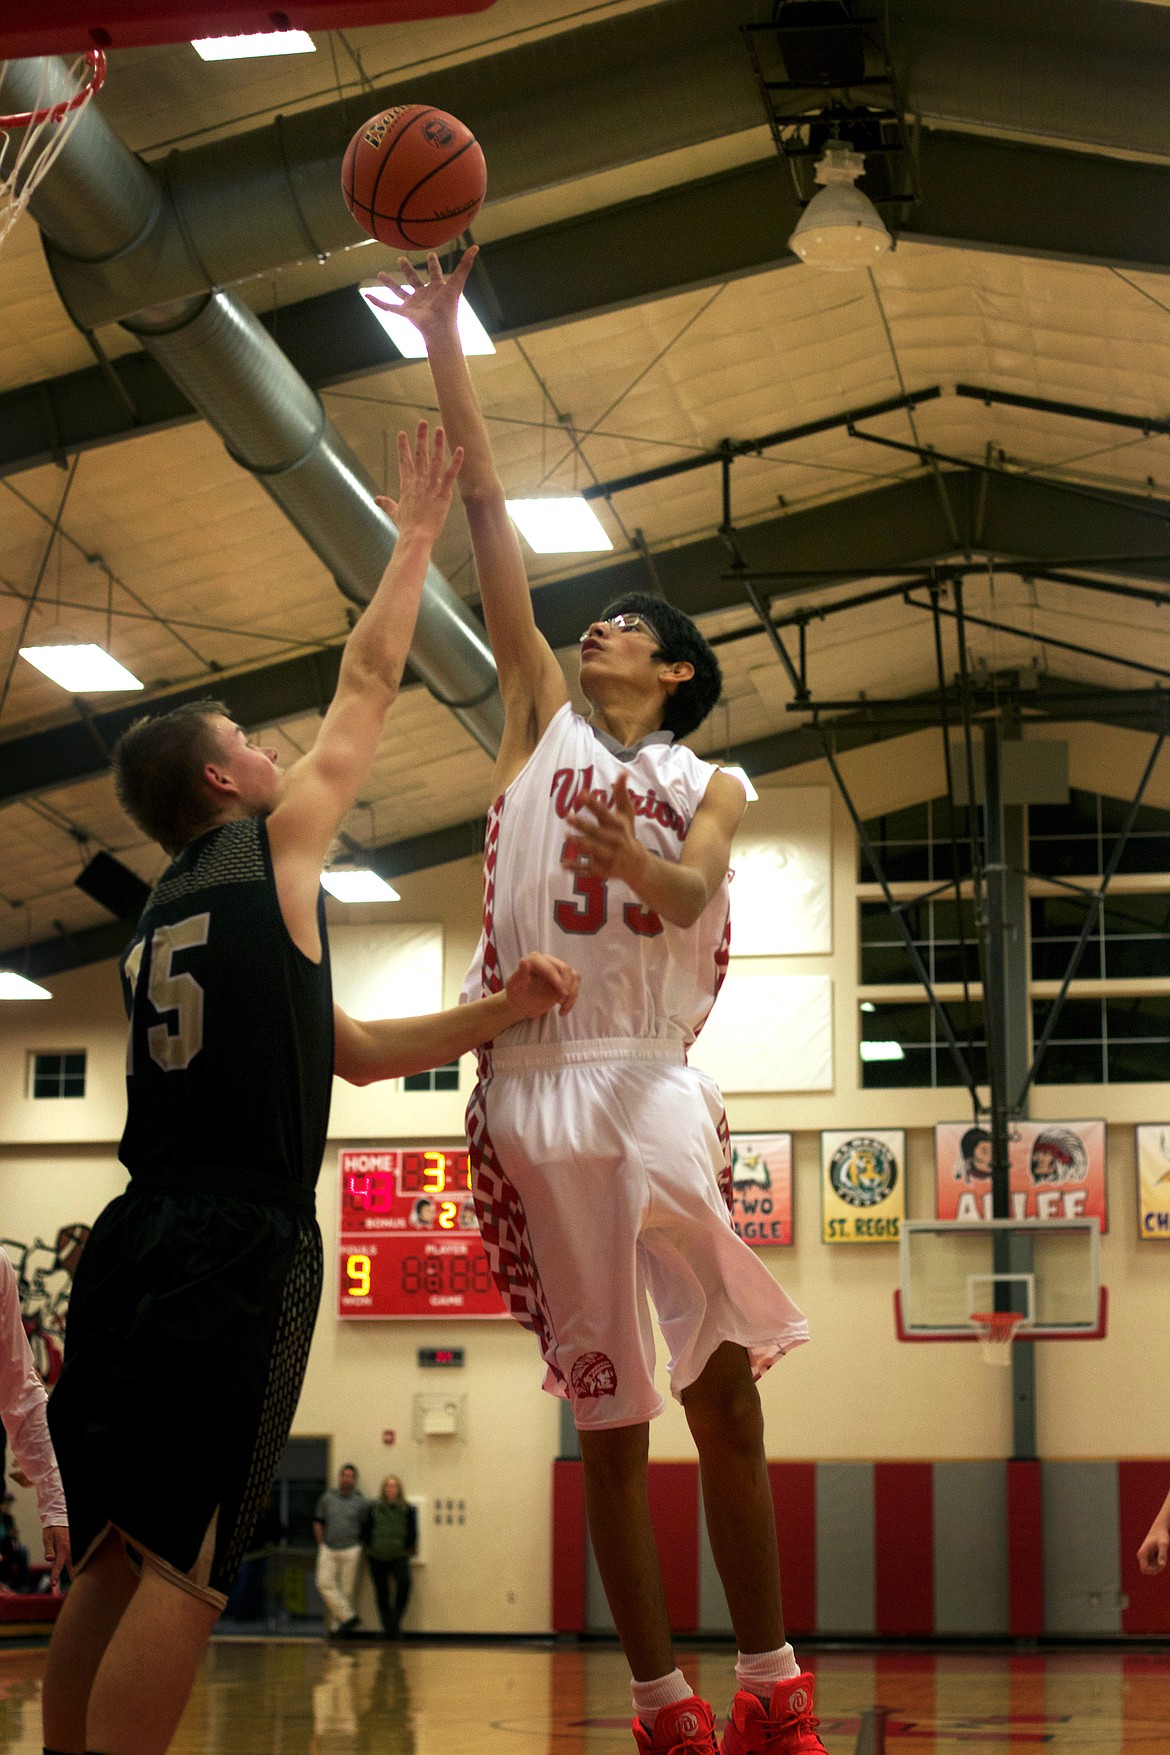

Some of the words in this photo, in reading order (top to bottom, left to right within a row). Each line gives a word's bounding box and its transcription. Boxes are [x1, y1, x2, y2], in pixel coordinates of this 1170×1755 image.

[343, 1155, 393, 1172] HOME
[347, 1172, 393, 1213] 43
[438, 1201, 457, 1229] 2
[734, 1221, 782, 1239] AGLE
[828, 1218, 850, 1238] ST.
[854, 1217, 899, 1238] REGIS
[346, 1253, 371, 1297] 9
